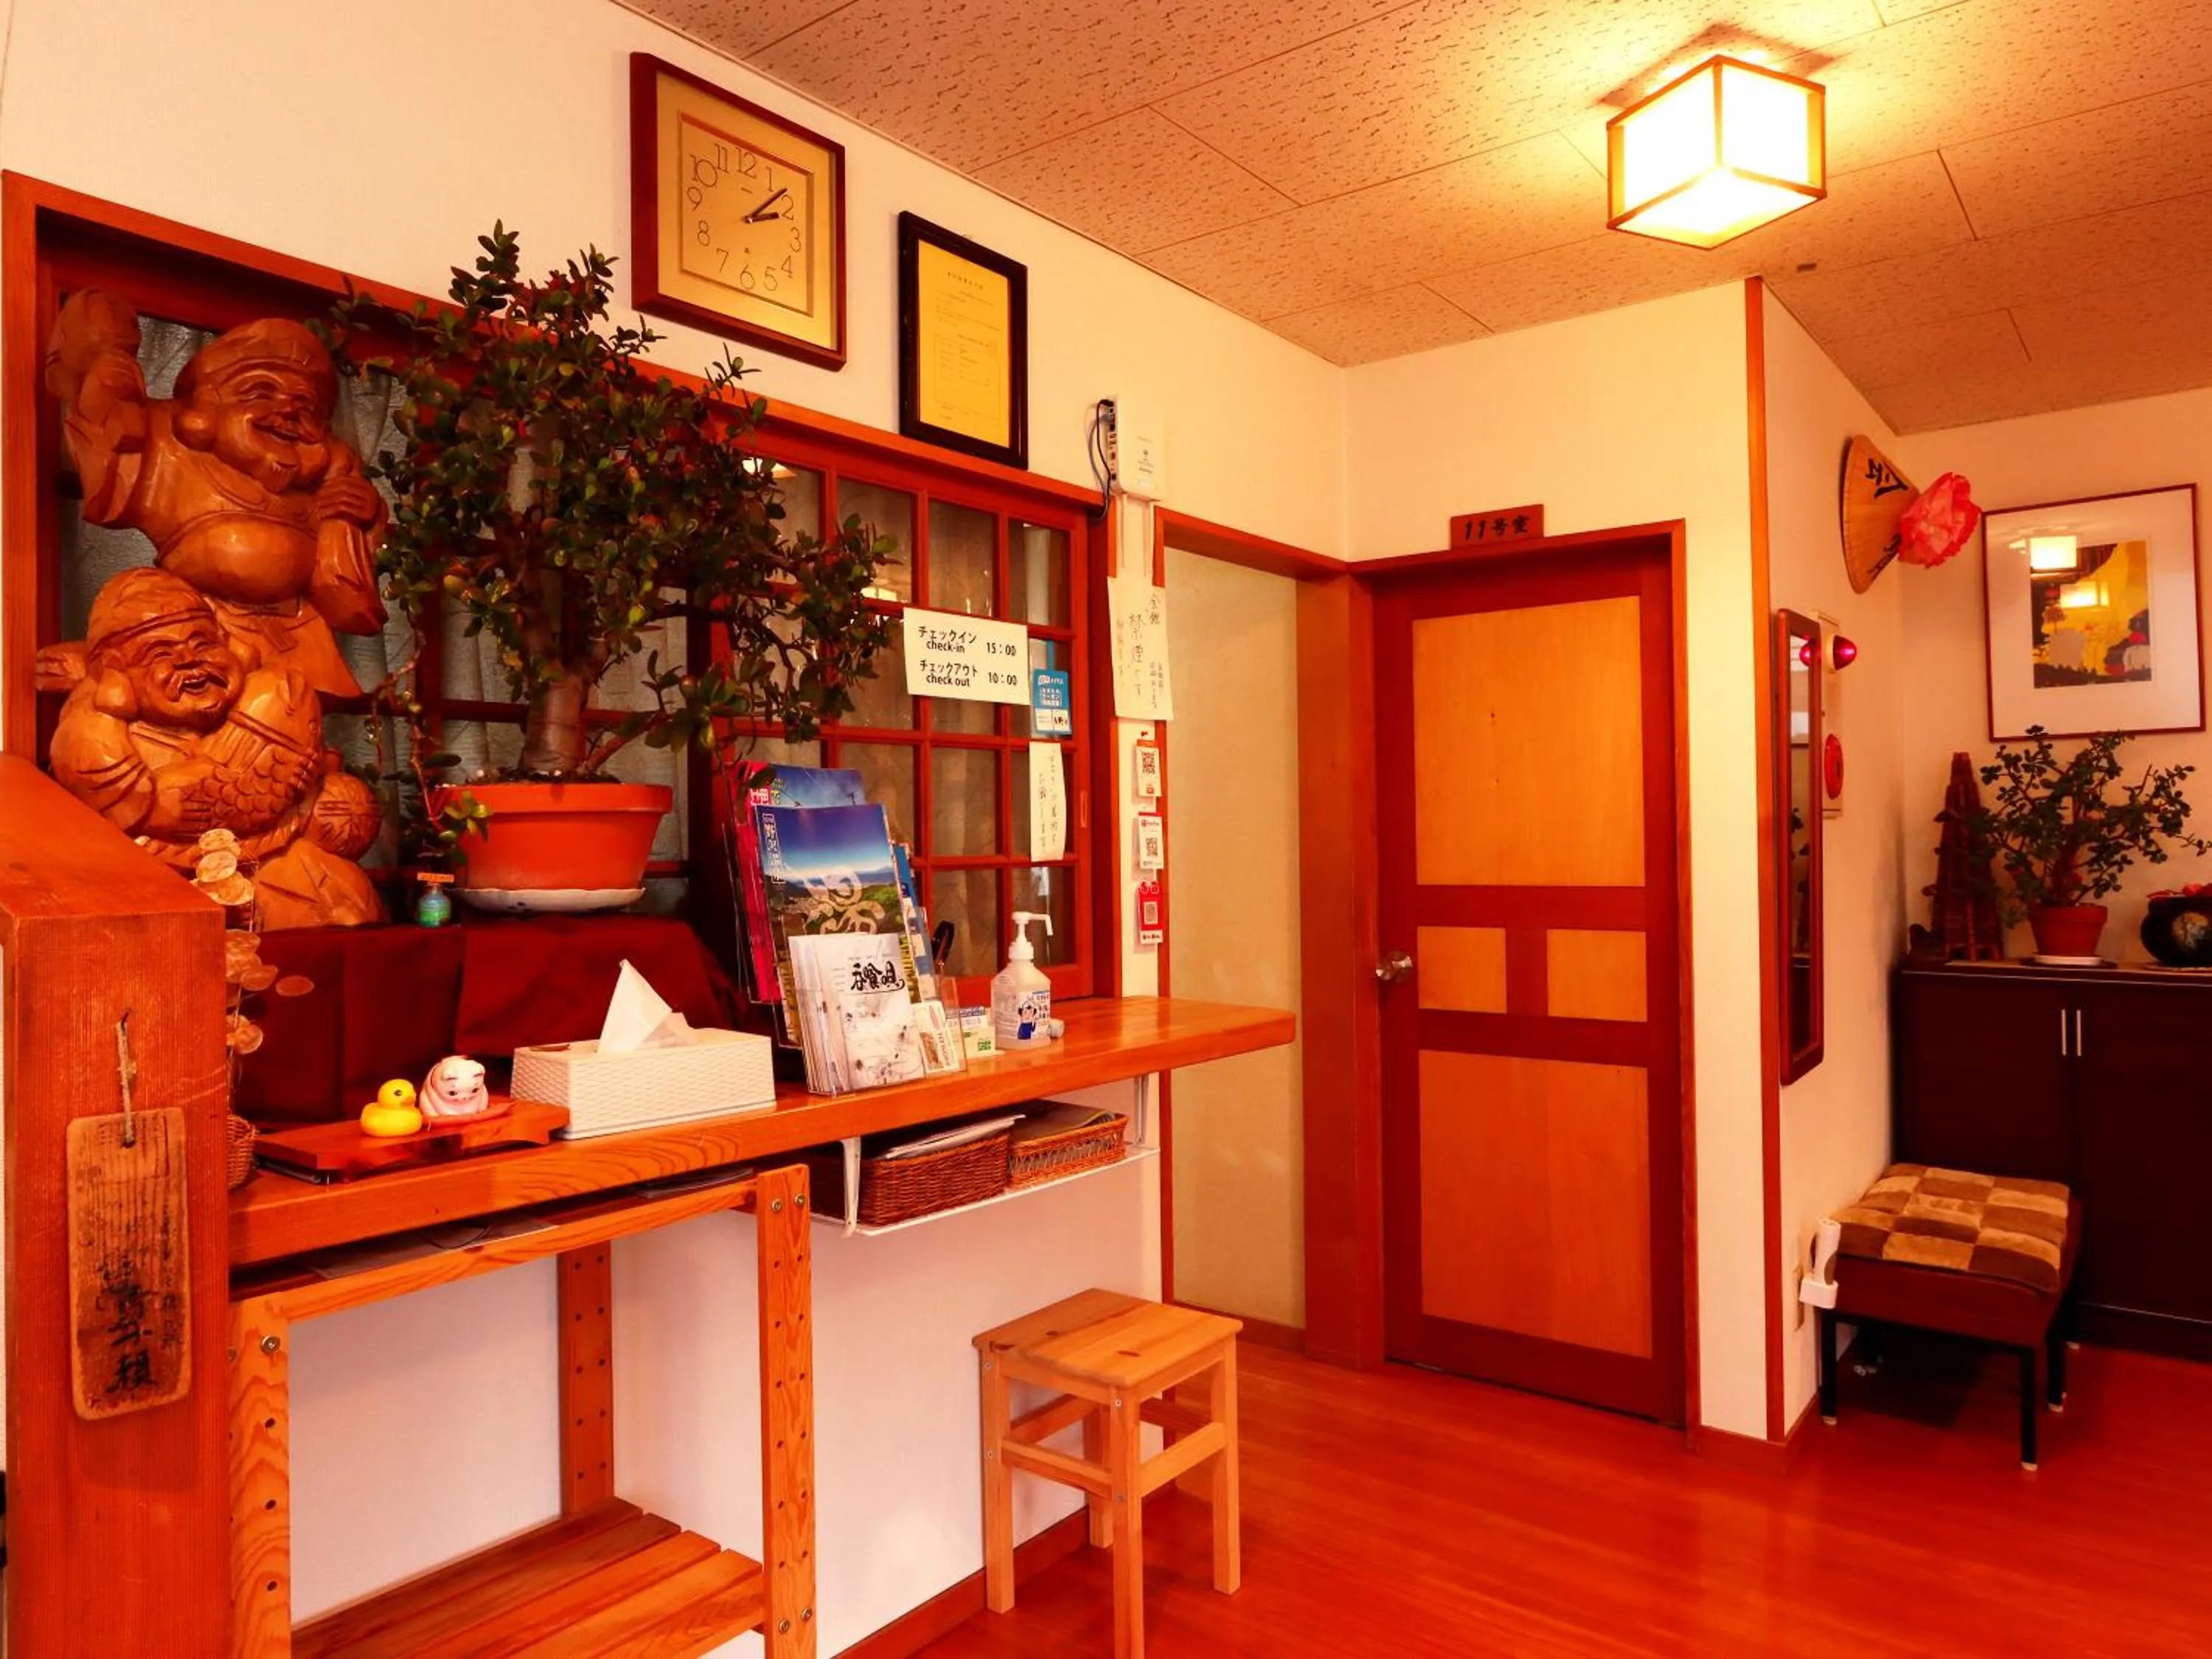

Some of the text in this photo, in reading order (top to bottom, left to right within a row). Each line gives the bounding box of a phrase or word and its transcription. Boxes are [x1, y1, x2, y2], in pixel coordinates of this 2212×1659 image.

[689, 154, 717, 187] 10
[714, 143, 730, 174] 11
[736, 147, 757, 179] 12
[766, 166, 774, 192] 1
[686, 187, 703, 212] 9
[781, 194, 794, 220] 2
[697, 220, 710, 247] 8
[790, 226, 801, 252] 3
[716, 248, 729, 272] 7
[781, 255, 793, 279] 4
[740, 264, 756, 290] 6
[763, 266, 778, 291] 5
[1464, 514, 1530, 540] 11号室
[918, 626, 977, 644] チェックイン
[926, 640, 965, 653] check-in
[919, 659, 978, 678] チェックアウト
[926, 672, 970, 687] check out
